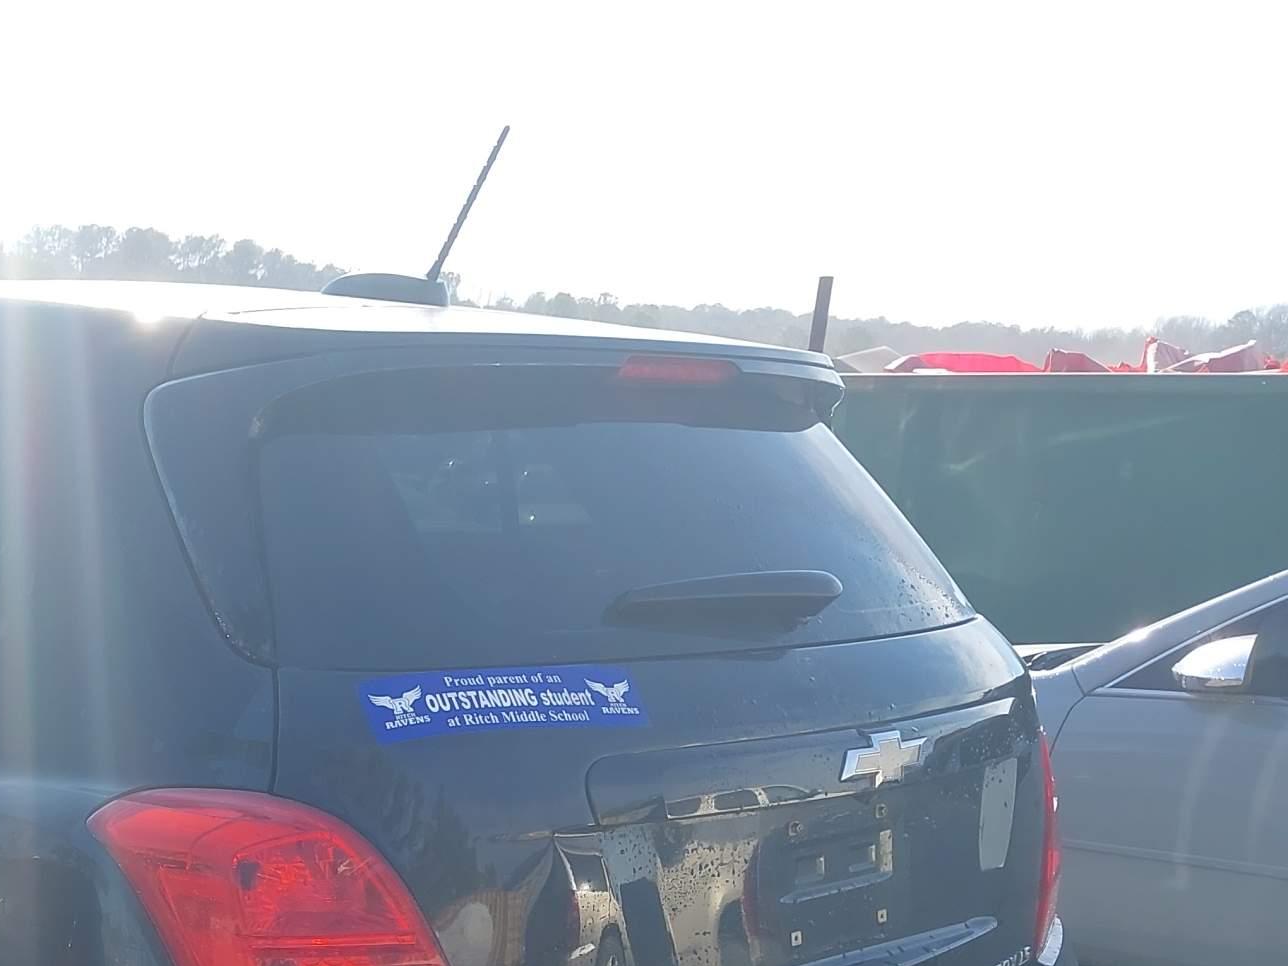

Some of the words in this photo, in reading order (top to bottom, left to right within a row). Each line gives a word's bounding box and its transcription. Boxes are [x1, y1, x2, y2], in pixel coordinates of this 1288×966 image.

[443, 675, 484, 687] Proud
[487, 674, 528, 688] parent
[531, 672, 543, 684] of
[546, 674, 562, 684] an
[425, 688, 538, 713] OUTSTANDING
[540, 688, 595, 706] student
[447, 715, 462, 727] at
[463, 712, 499, 726] Ritch
[502, 710, 548, 724] Middle
[549, 709, 590, 722] School
[601, 706, 640, 715] RAVENS
[385, 714, 431, 730] RAVENS
